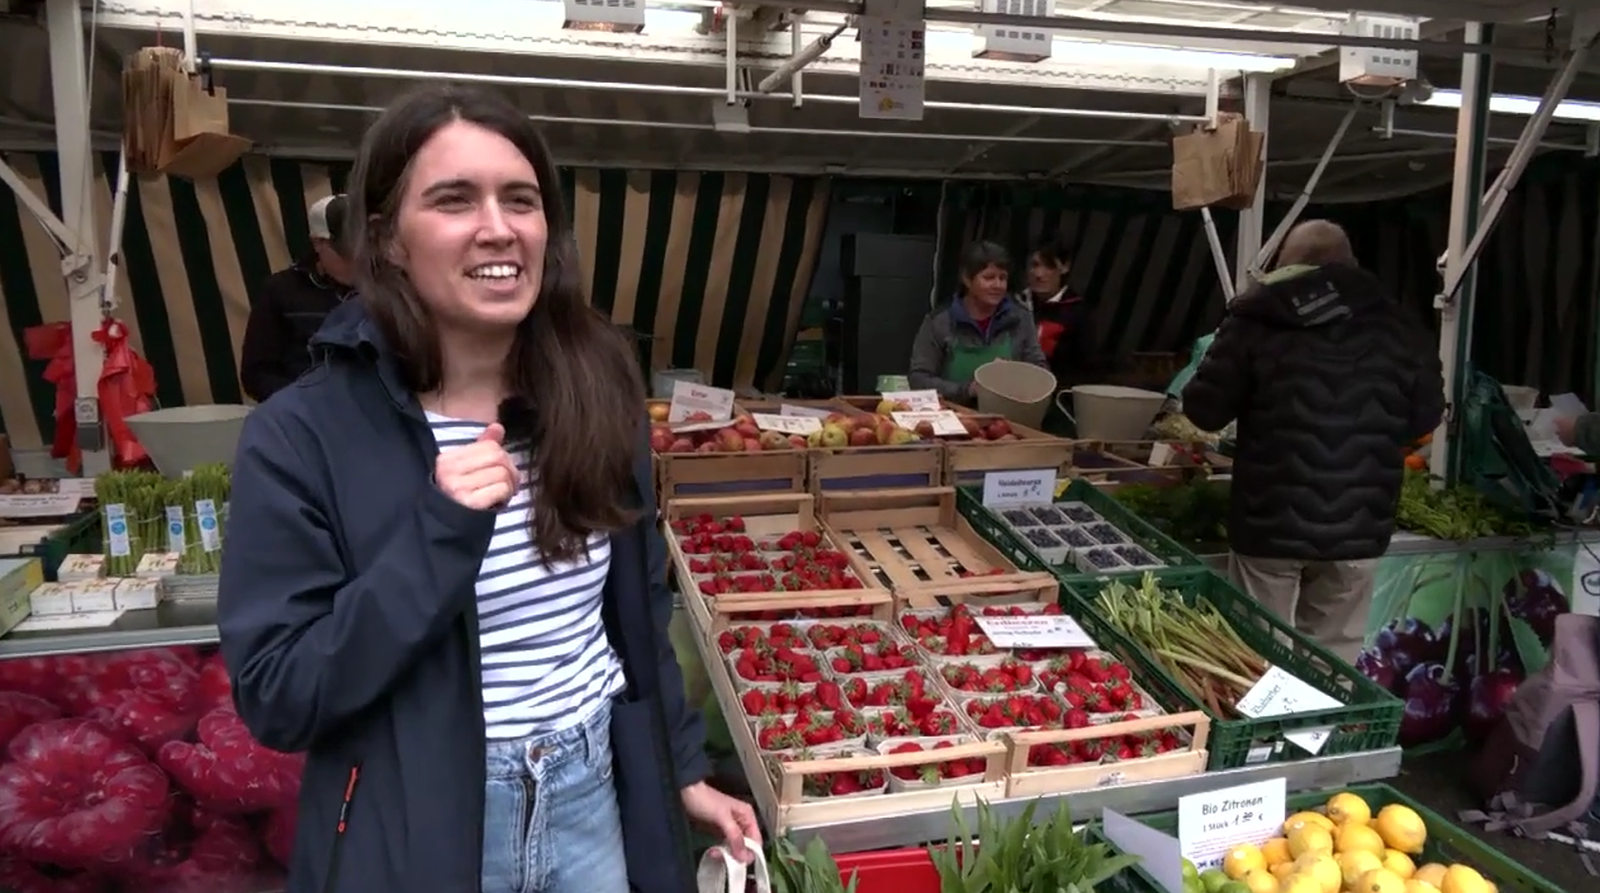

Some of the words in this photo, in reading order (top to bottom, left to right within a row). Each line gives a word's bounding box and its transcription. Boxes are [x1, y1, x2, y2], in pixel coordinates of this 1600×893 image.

[1202, 803, 1218, 816] Bio
[1221, 796, 1263, 813] Zitronen
[1208, 820, 1229, 832] Stück
